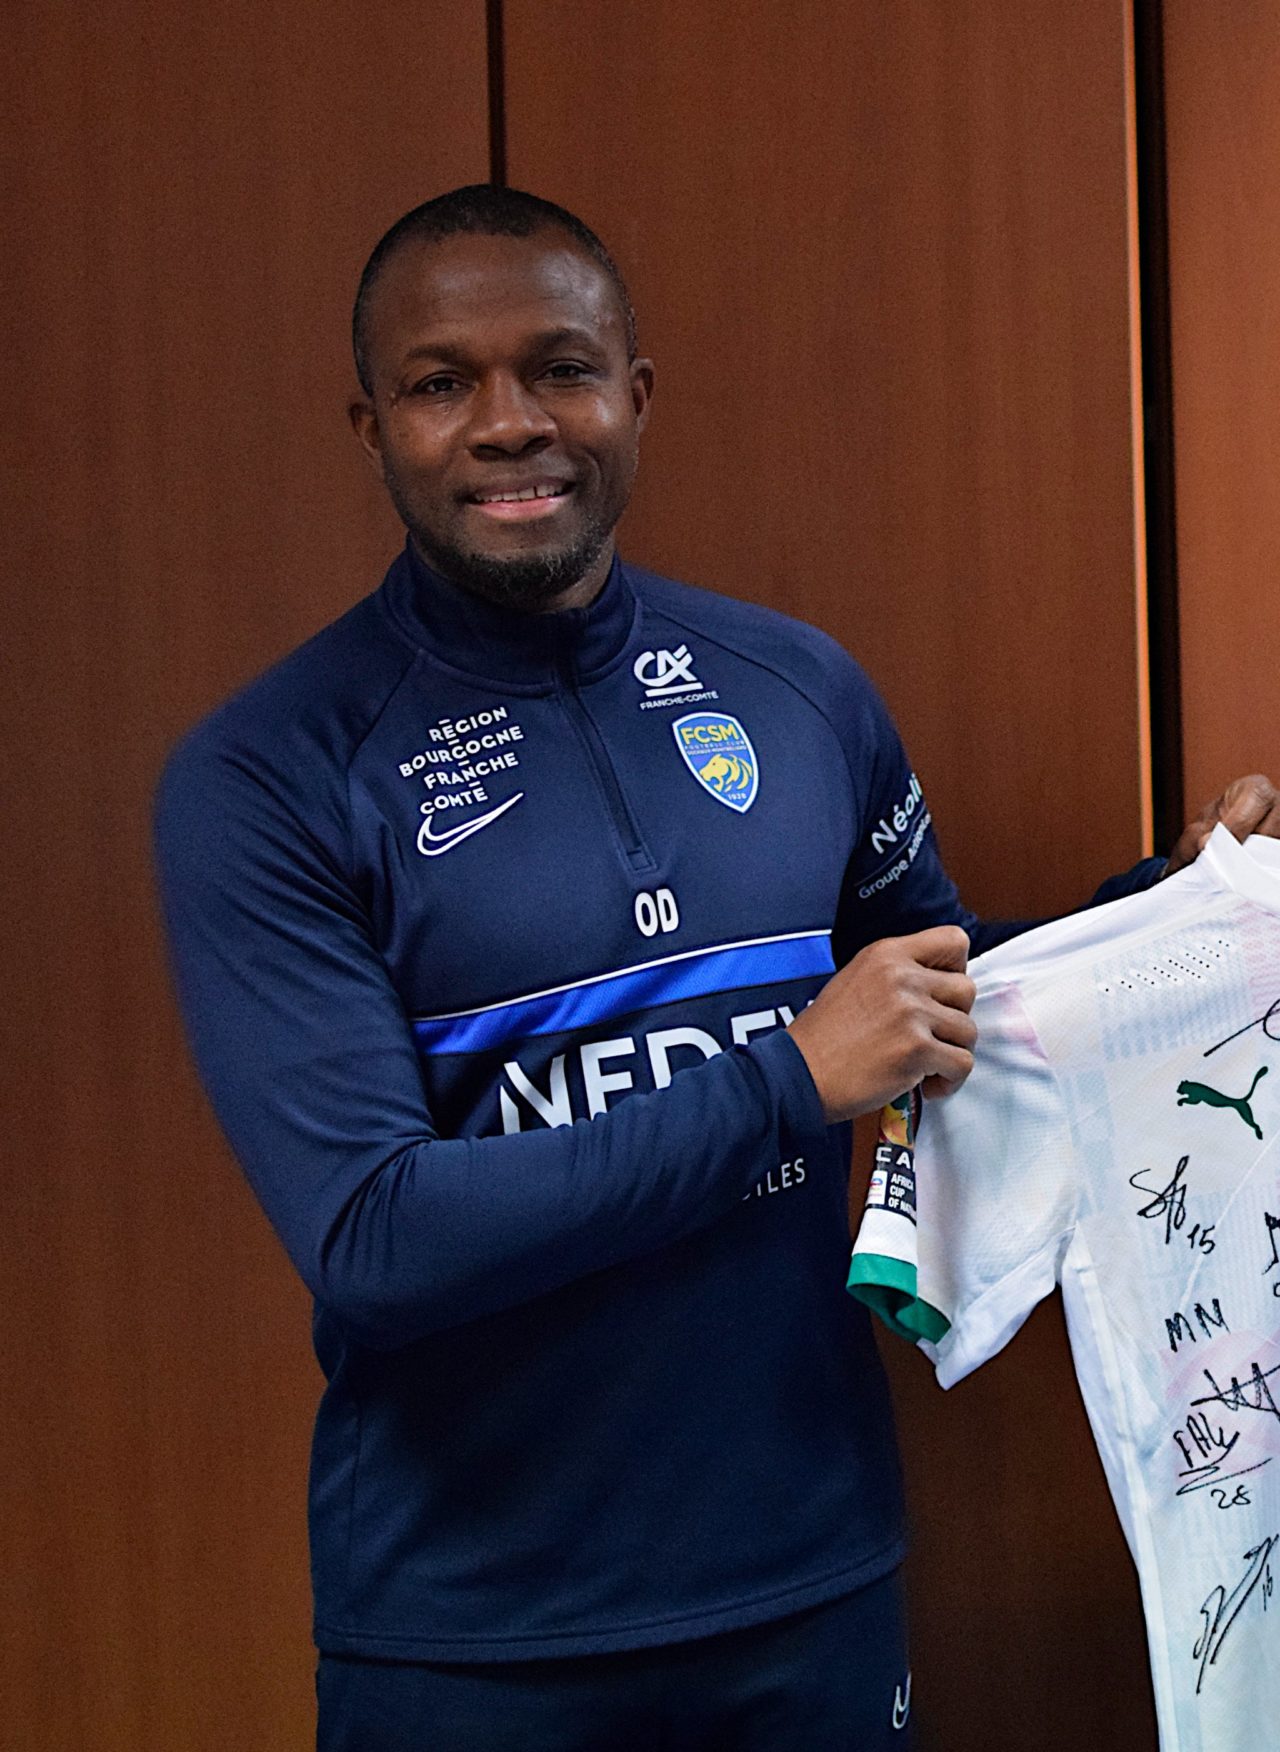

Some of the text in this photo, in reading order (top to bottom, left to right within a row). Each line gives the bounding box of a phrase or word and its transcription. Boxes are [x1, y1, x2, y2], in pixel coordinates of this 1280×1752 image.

[429, 707, 508, 742] RÉGION
[680, 723, 739, 744] FCSM
[399, 726, 524, 777] BOURGOGNE
[424, 752, 519, 790] FRANCHE
[859, 859, 909, 899] Groupe
[634, 888, 680, 937] OD
[876, 1146, 916, 1172] CA
[888, 1197, 900, 1209] OF
[889, 1184, 906, 1198] CUP
[1187, 1223, 1216, 1255] 15
[1210, 1485, 1252, 1509] 28
